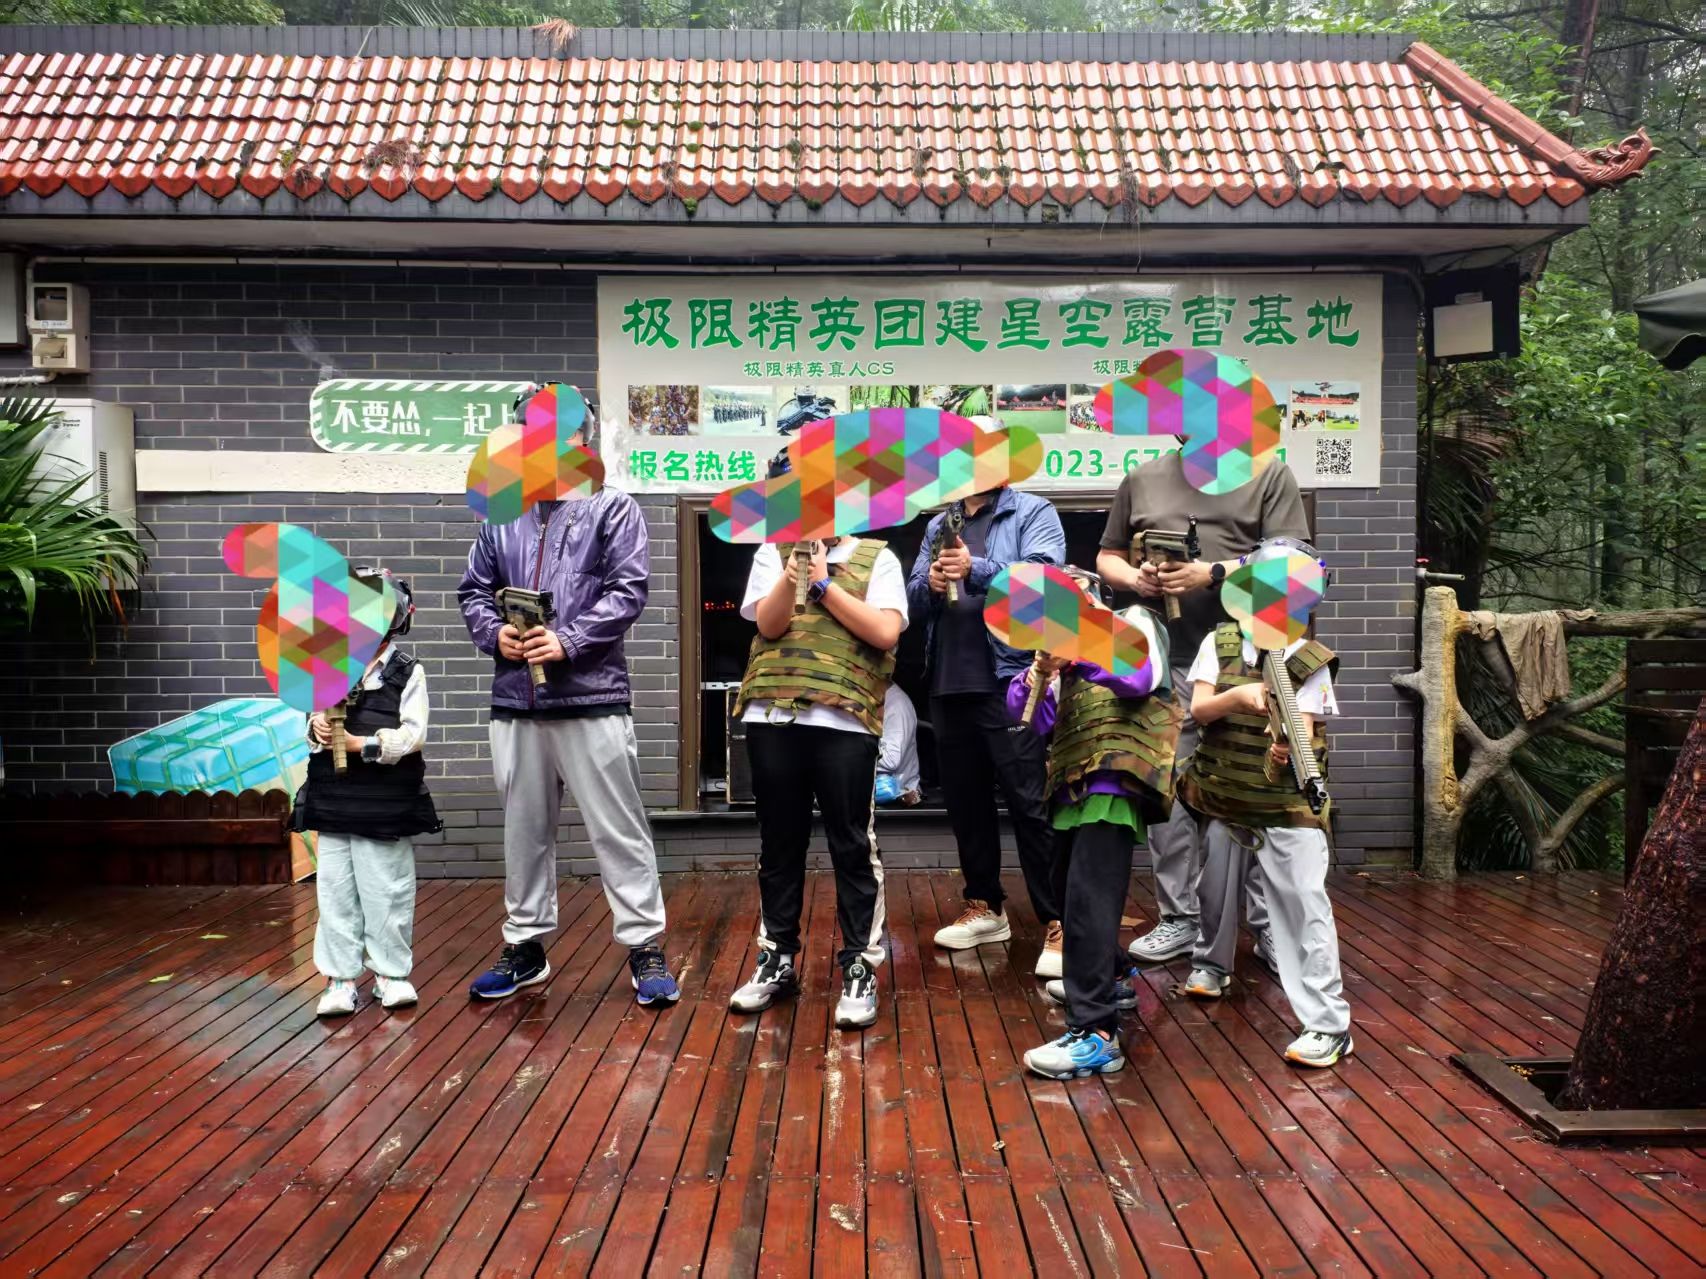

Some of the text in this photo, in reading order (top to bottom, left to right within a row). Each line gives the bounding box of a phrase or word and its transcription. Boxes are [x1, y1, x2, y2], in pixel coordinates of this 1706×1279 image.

[621, 294, 1361, 352] 极限精英团建星空露营基地
[743, 360, 895, 377] 极限精英真人CS
[629, 449, 757, 481] 报名热线
